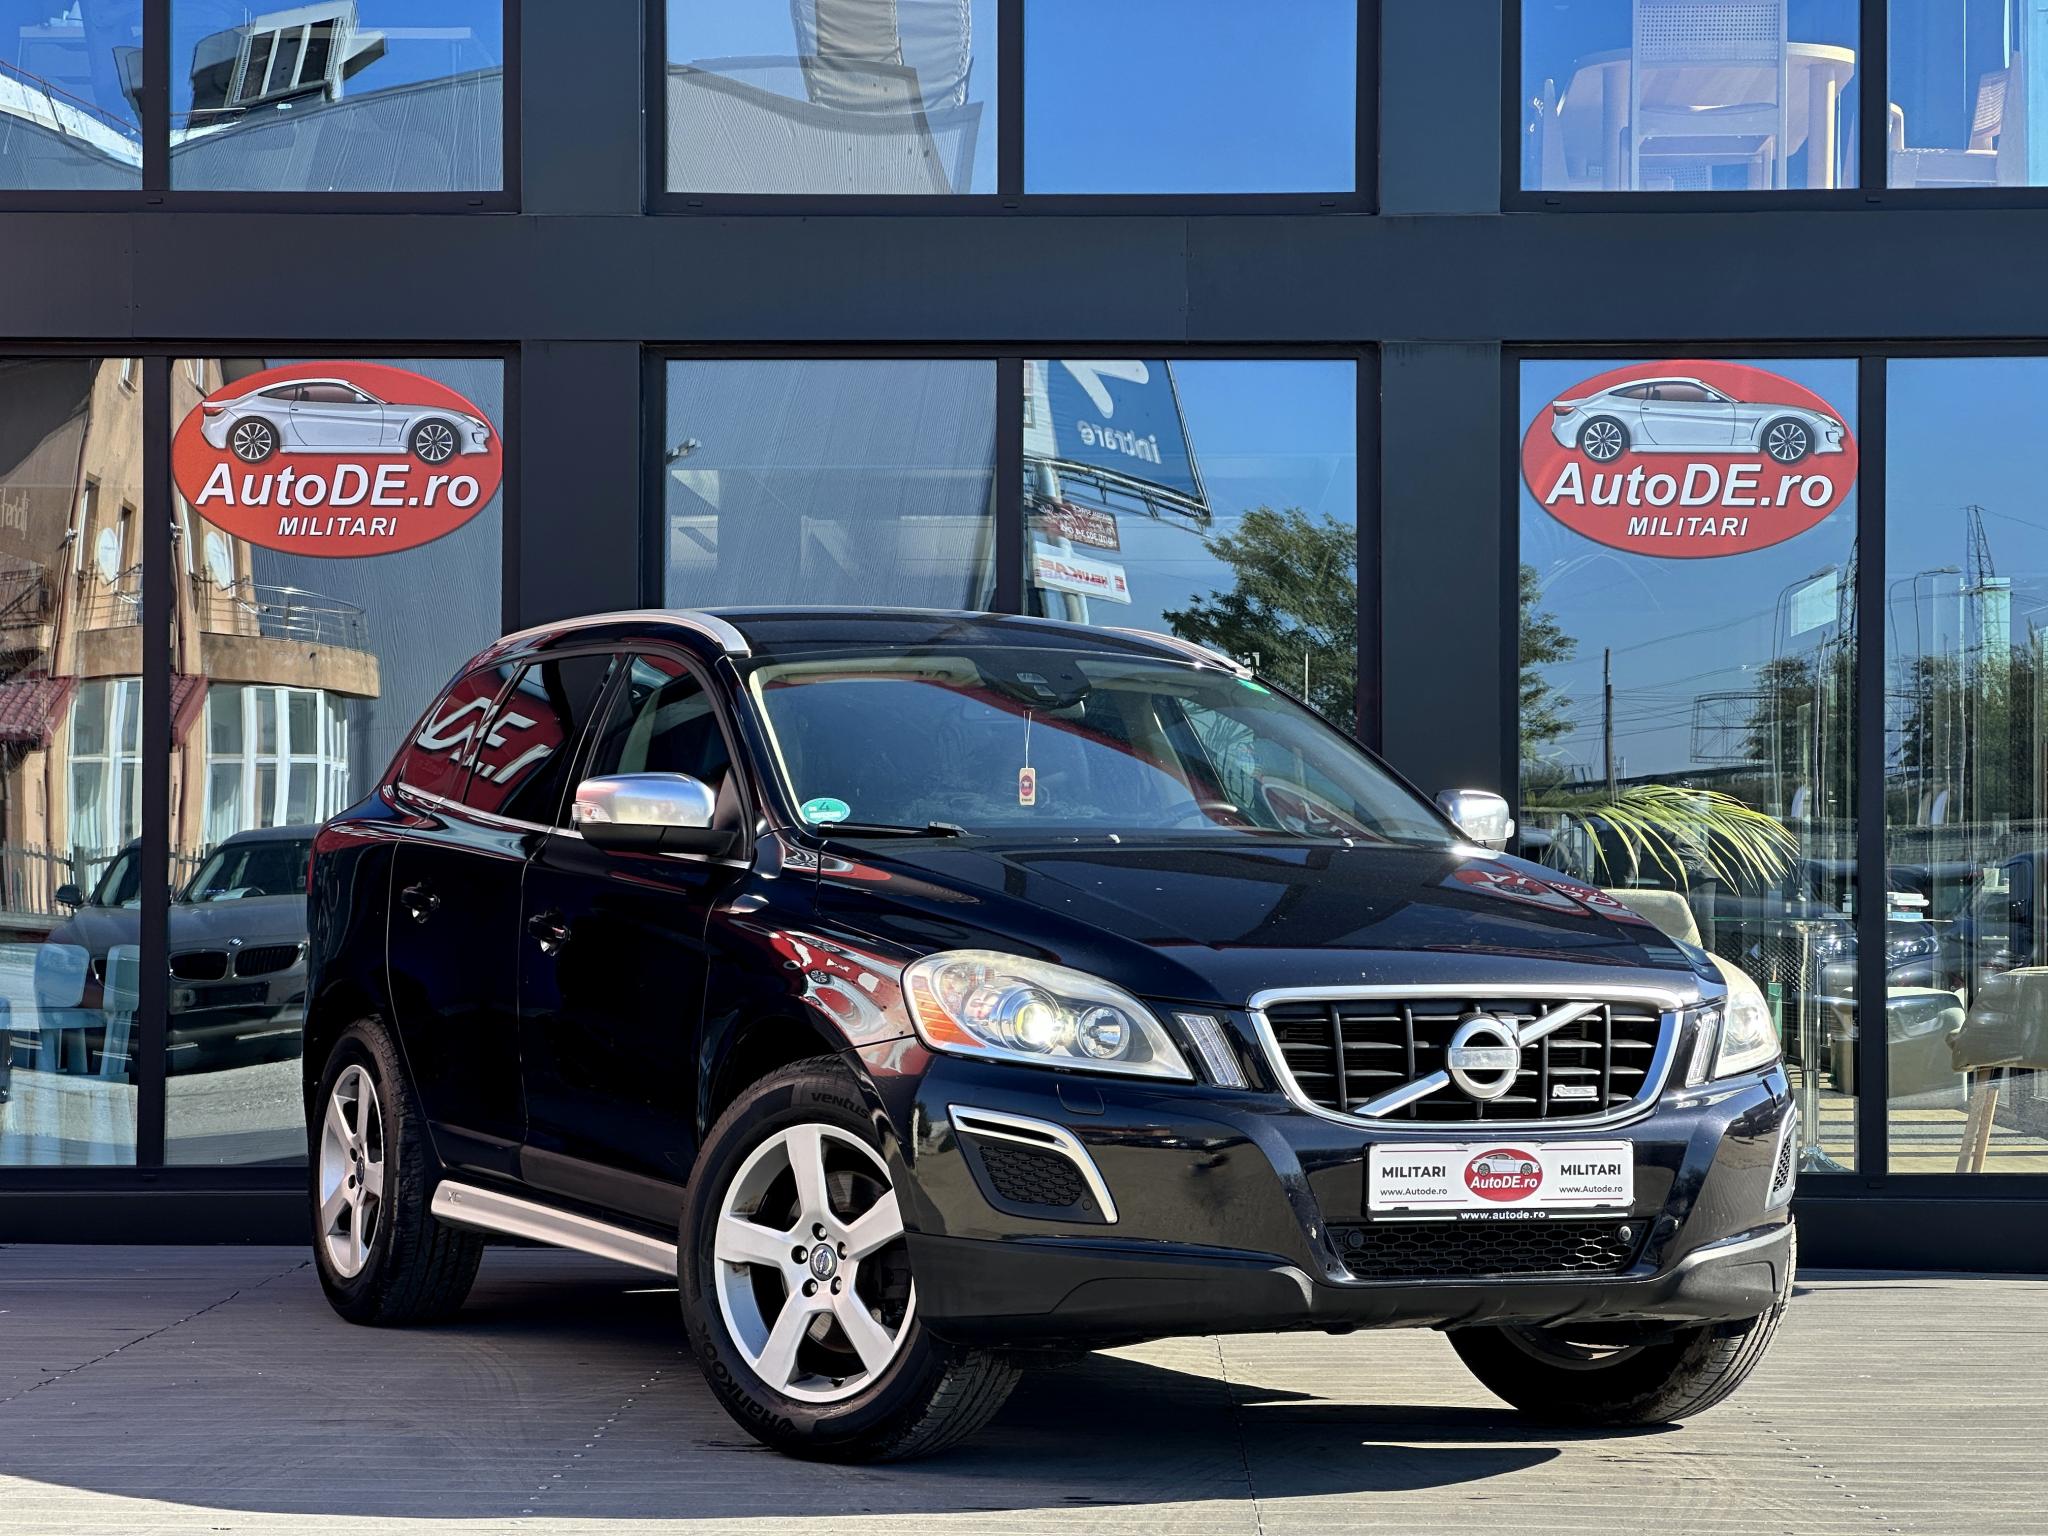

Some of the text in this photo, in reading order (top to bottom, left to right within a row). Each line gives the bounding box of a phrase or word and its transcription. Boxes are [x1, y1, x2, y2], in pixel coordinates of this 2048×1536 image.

[195, 462, 481, 507] AutoDE.ro
[1545, 462, 1834, 507] AutoDE.ro
[278, 517, 398, 536] MILITARI
[1627, 517, 1749, 536] MILITARI
[1381, 1166, 1446, 1178] MILITARI
[1560, 1164, 1621, 1176] MILITARI
[1469, 1175, 1538, 1189] AutoDE.ro
[1380, 1186, 1448, 1196] www.Autode.ro
[1559, 1184, 1623, 1194] www.Autode.ro
[1460, 1210, 1546, 1220] www.autode.ro
